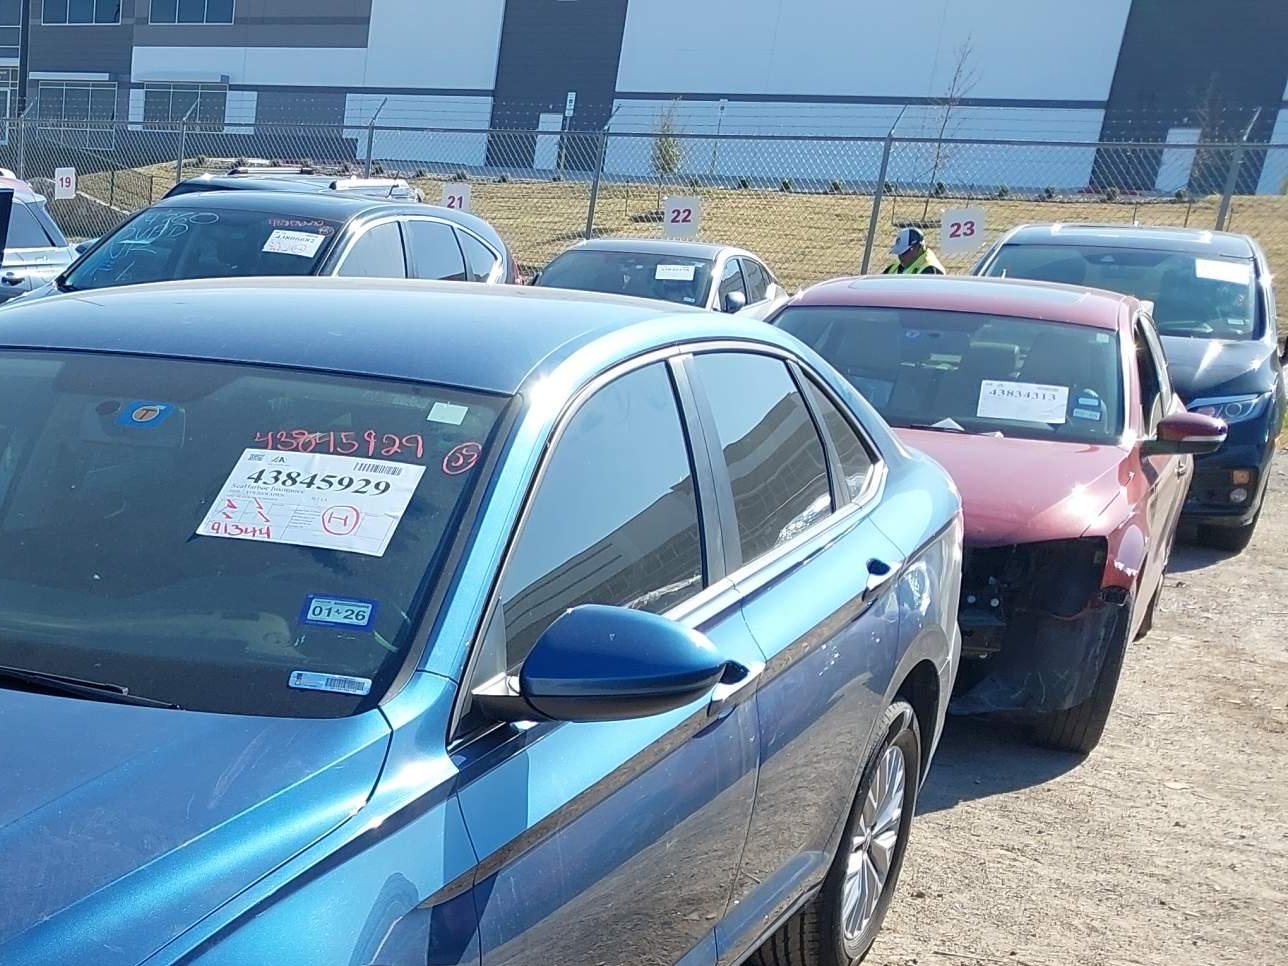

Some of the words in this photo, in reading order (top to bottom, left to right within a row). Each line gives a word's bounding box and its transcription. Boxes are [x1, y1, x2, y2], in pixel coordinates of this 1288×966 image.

[58, 176, 72, 189] 19
[447, 195, 463, 209] 21
[671, 208, 692, 223] 22
[949, 220, 976, 239] 23
[988, 388, 1057, 401] 43834313
[253, 430, 425, 459] 43845929
[246, 468, 391, 496] 43845929
